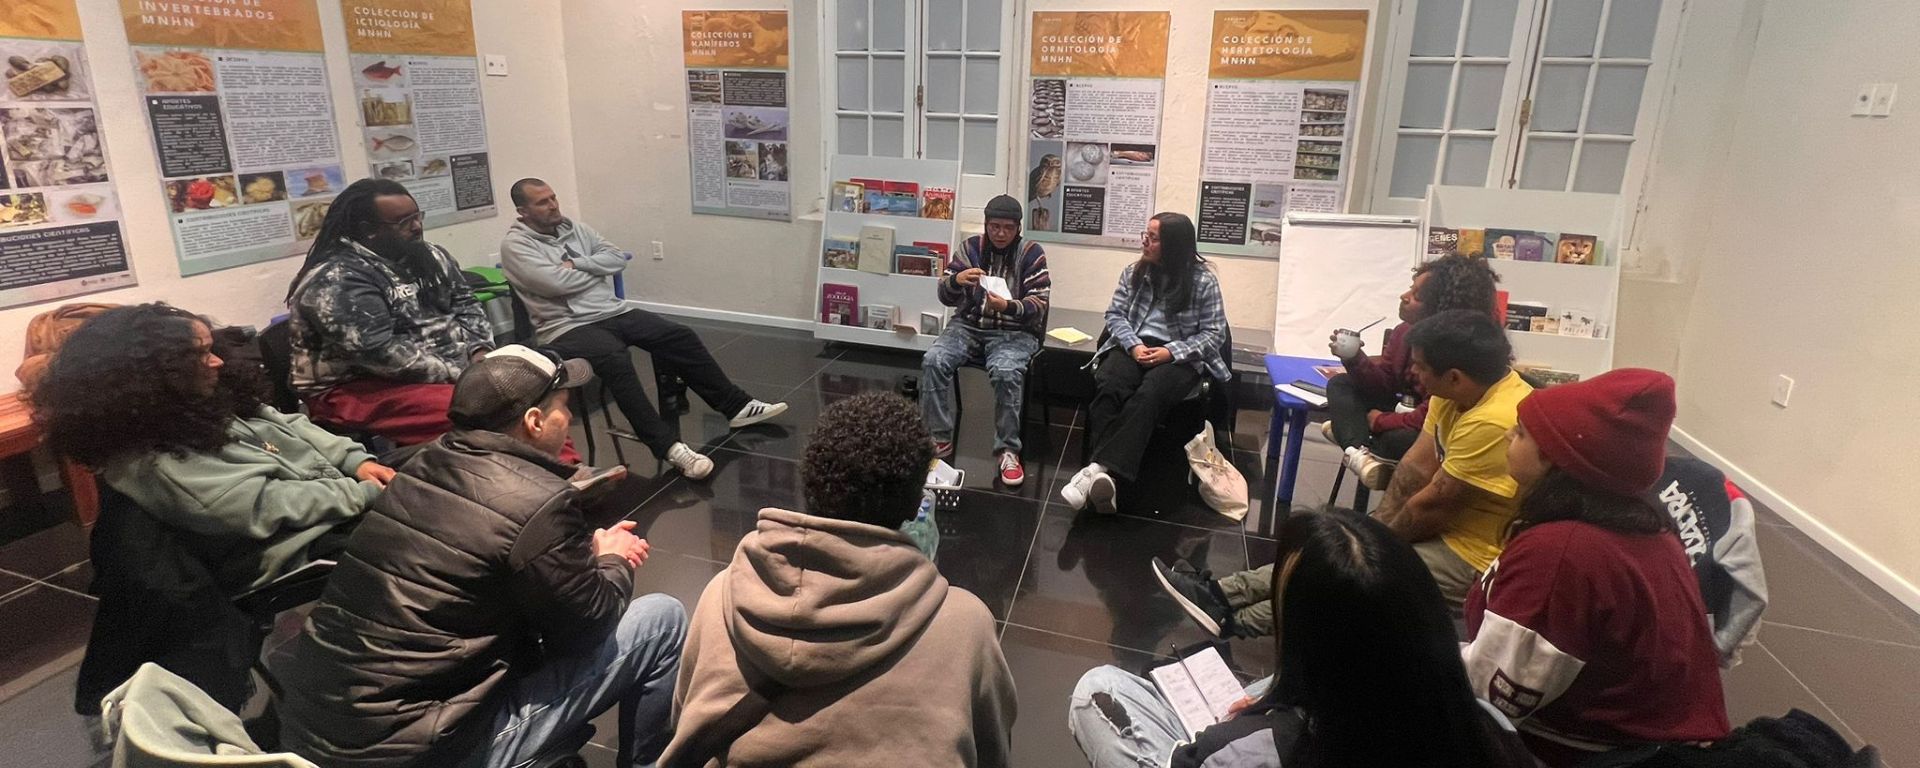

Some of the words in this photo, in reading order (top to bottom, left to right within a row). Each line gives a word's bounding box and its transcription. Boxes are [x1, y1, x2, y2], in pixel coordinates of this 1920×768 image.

[138, 1, 275, 20] INVERTEBRADOS
[354, 6, 418, 19] COLECCIÓN
[421, 12, 433, 20] DE
[142, 14, 194, 27] MNHN
[355, 18, 420, 29] ICTIOLOGÍA
[357, 28, 392, 38] MNHN
[691, 31, 739, 39] COLECCIÓN
[1041, 35, 1104, 43] COLECCIÓN
[1222, 35, 1293, 44] COLECCIÓN
[1298, 36, 1313, 44] DE
[691, 40, 740, 48] MAMÍFEROS
[1221, 46, 1313, 55] HERPETOLOGÍA
[1041, 55, 1073, 63] MNHN
[1221, 57, 1256, 65] MNHN
